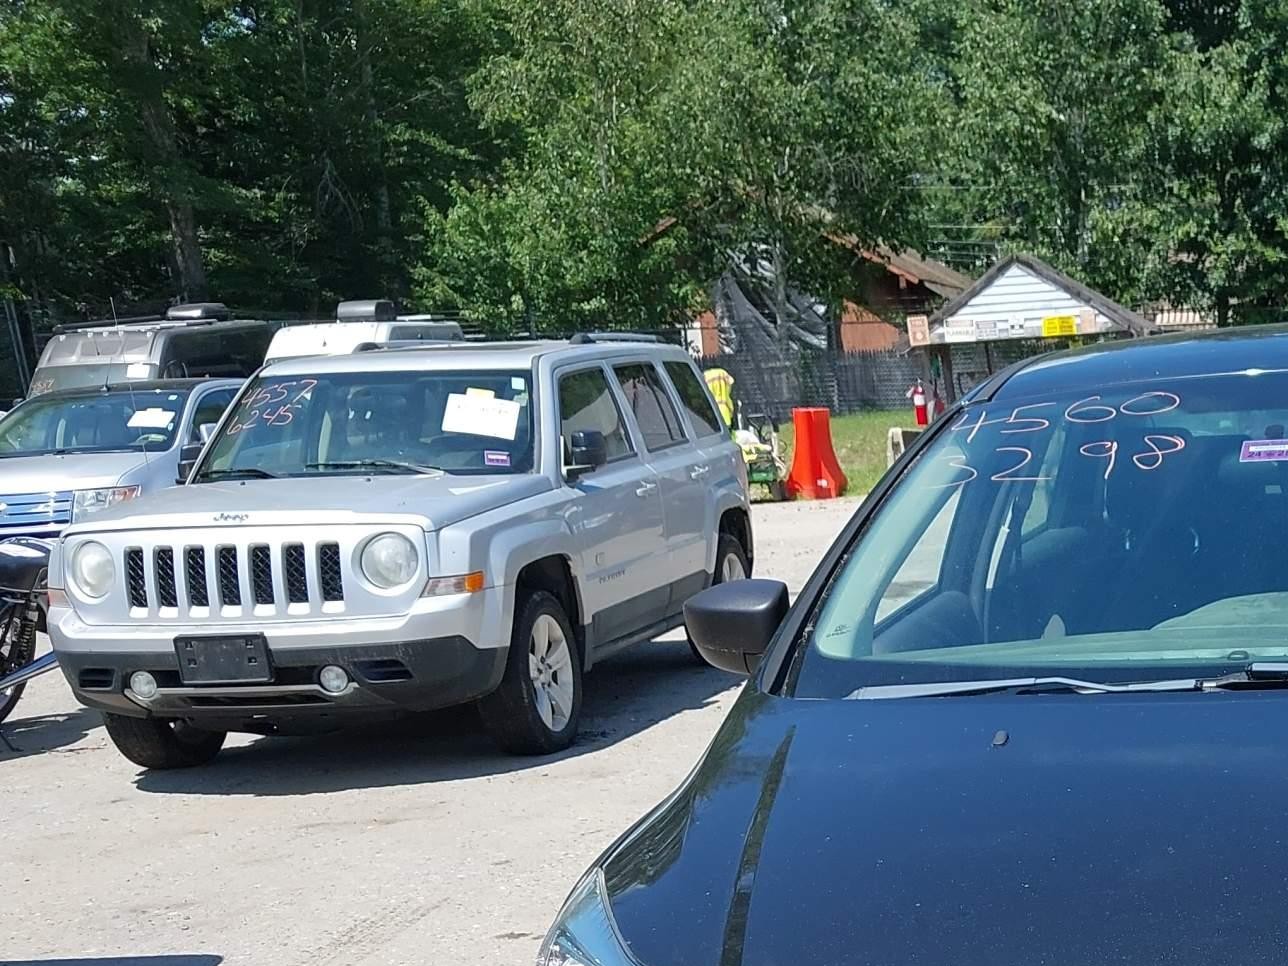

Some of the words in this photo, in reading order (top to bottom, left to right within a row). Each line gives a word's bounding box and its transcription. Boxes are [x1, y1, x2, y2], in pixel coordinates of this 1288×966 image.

[241, 379, 318, 412] 4557
[226, 404, 302, 436] 6245
[951, 390, 1182, 443] 4560
[213, 513, 249, 523] Jeep
